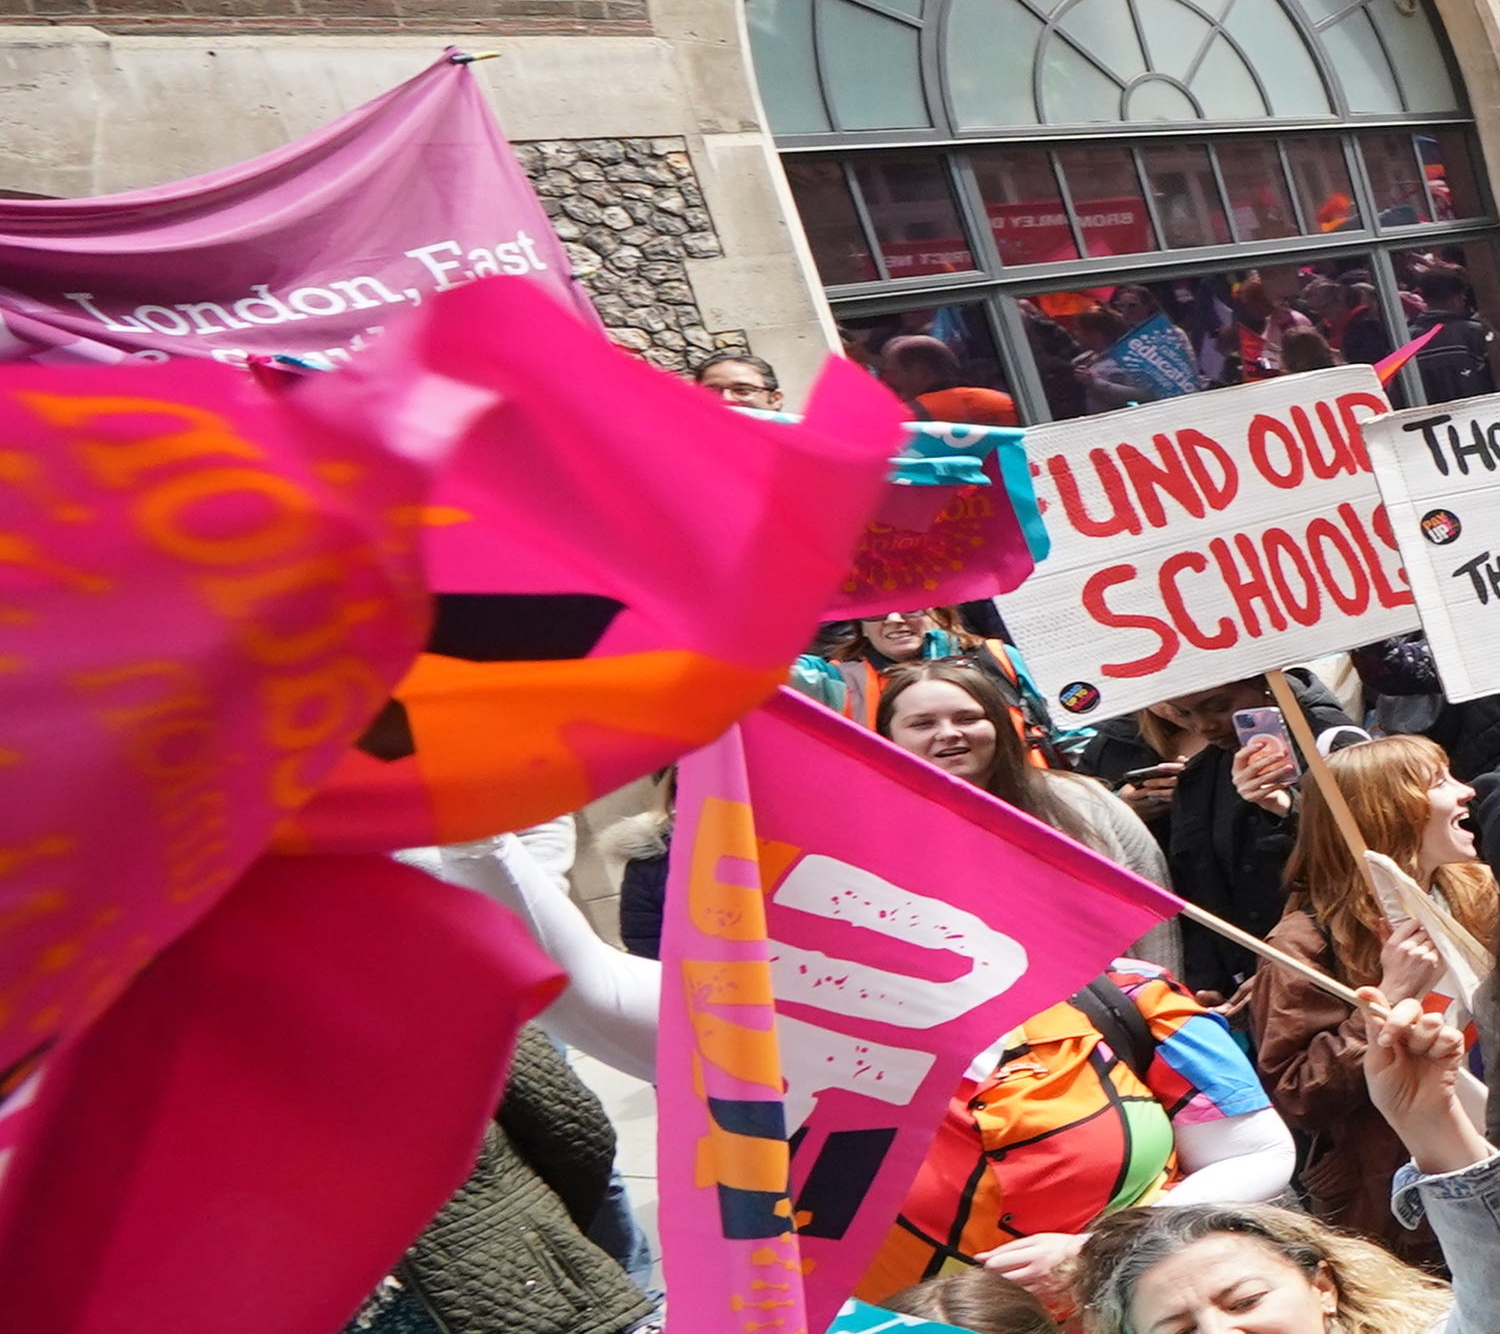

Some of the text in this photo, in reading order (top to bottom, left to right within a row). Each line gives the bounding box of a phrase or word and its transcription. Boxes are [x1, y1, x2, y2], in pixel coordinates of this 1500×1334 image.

[64, 230, 547, 337] London, East
[1028, 428, 1240, 538] UND
